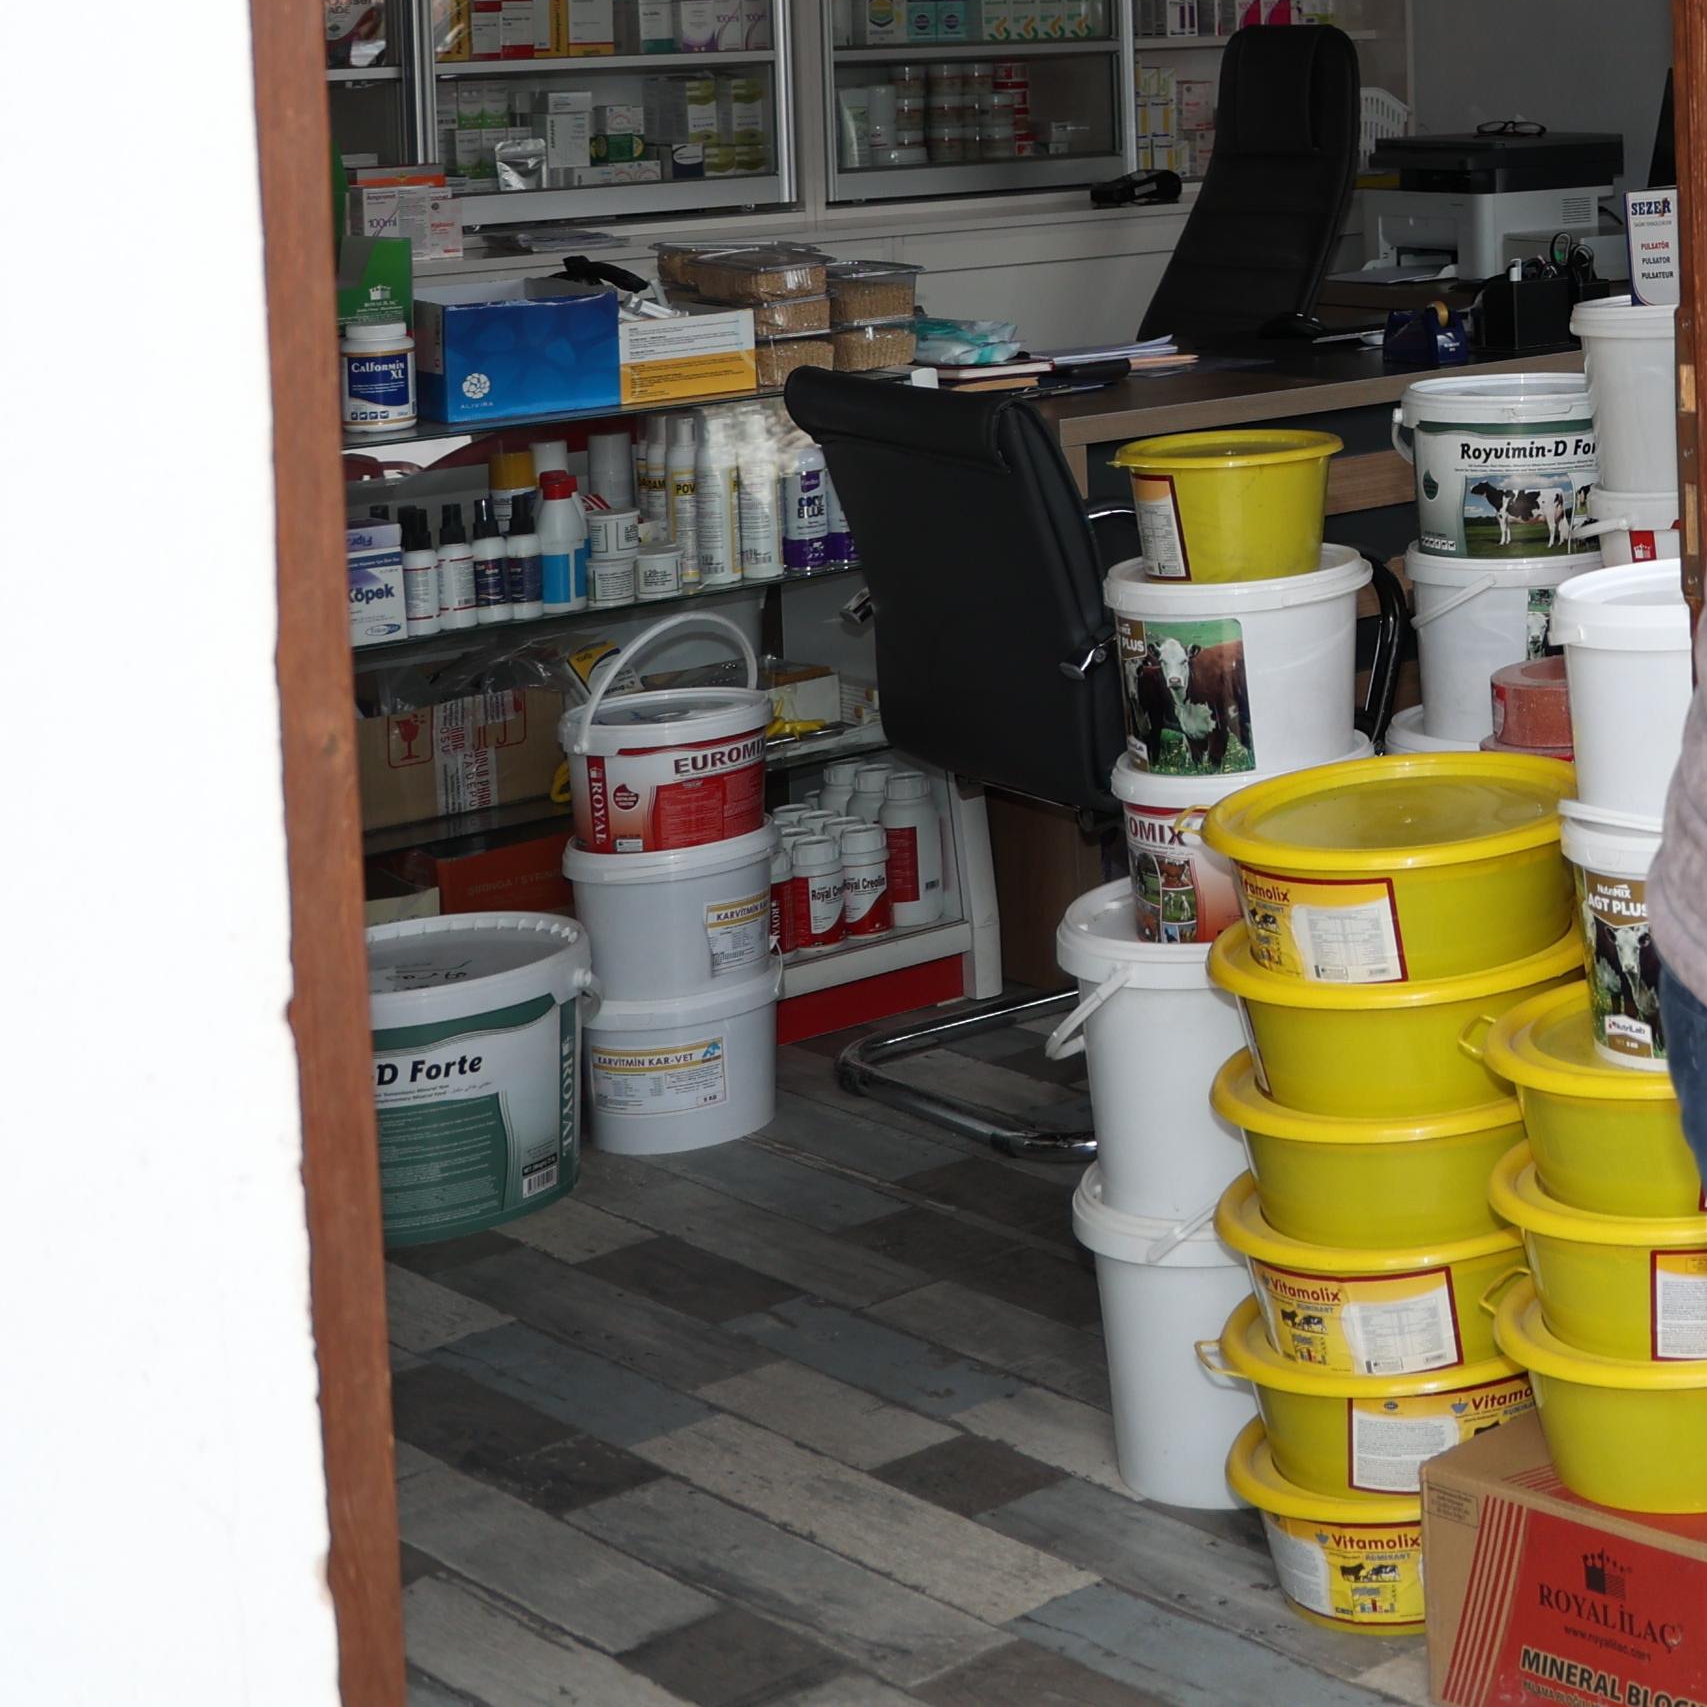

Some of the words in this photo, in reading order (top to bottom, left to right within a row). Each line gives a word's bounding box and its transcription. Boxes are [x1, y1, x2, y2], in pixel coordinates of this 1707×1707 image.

[1631, 198, 1671, 216] SEZER
[368, 216, 397, 230] 100ml
[1641, 271, 1674, 279] PULSATEUR
[1460, 440, 1567, 463] Royvimin-D
[591, 782, 607, 845] ROYAL
[811, 885, 830, 902] Royal
[409, 1055, 483, 1083] Forte
[648, 1053, 693, 1066] KAR-VET
[561, 1059, 574, 1157] ROYAL
[1270, 1276, 1341, 1302] Vitamolix
[1331, 1533, 1421, 1550] Vitamolix
[1538, 1582, 1617, 1630] ROYAL
[1520, 1645, 1622, 1701] MINERAL
